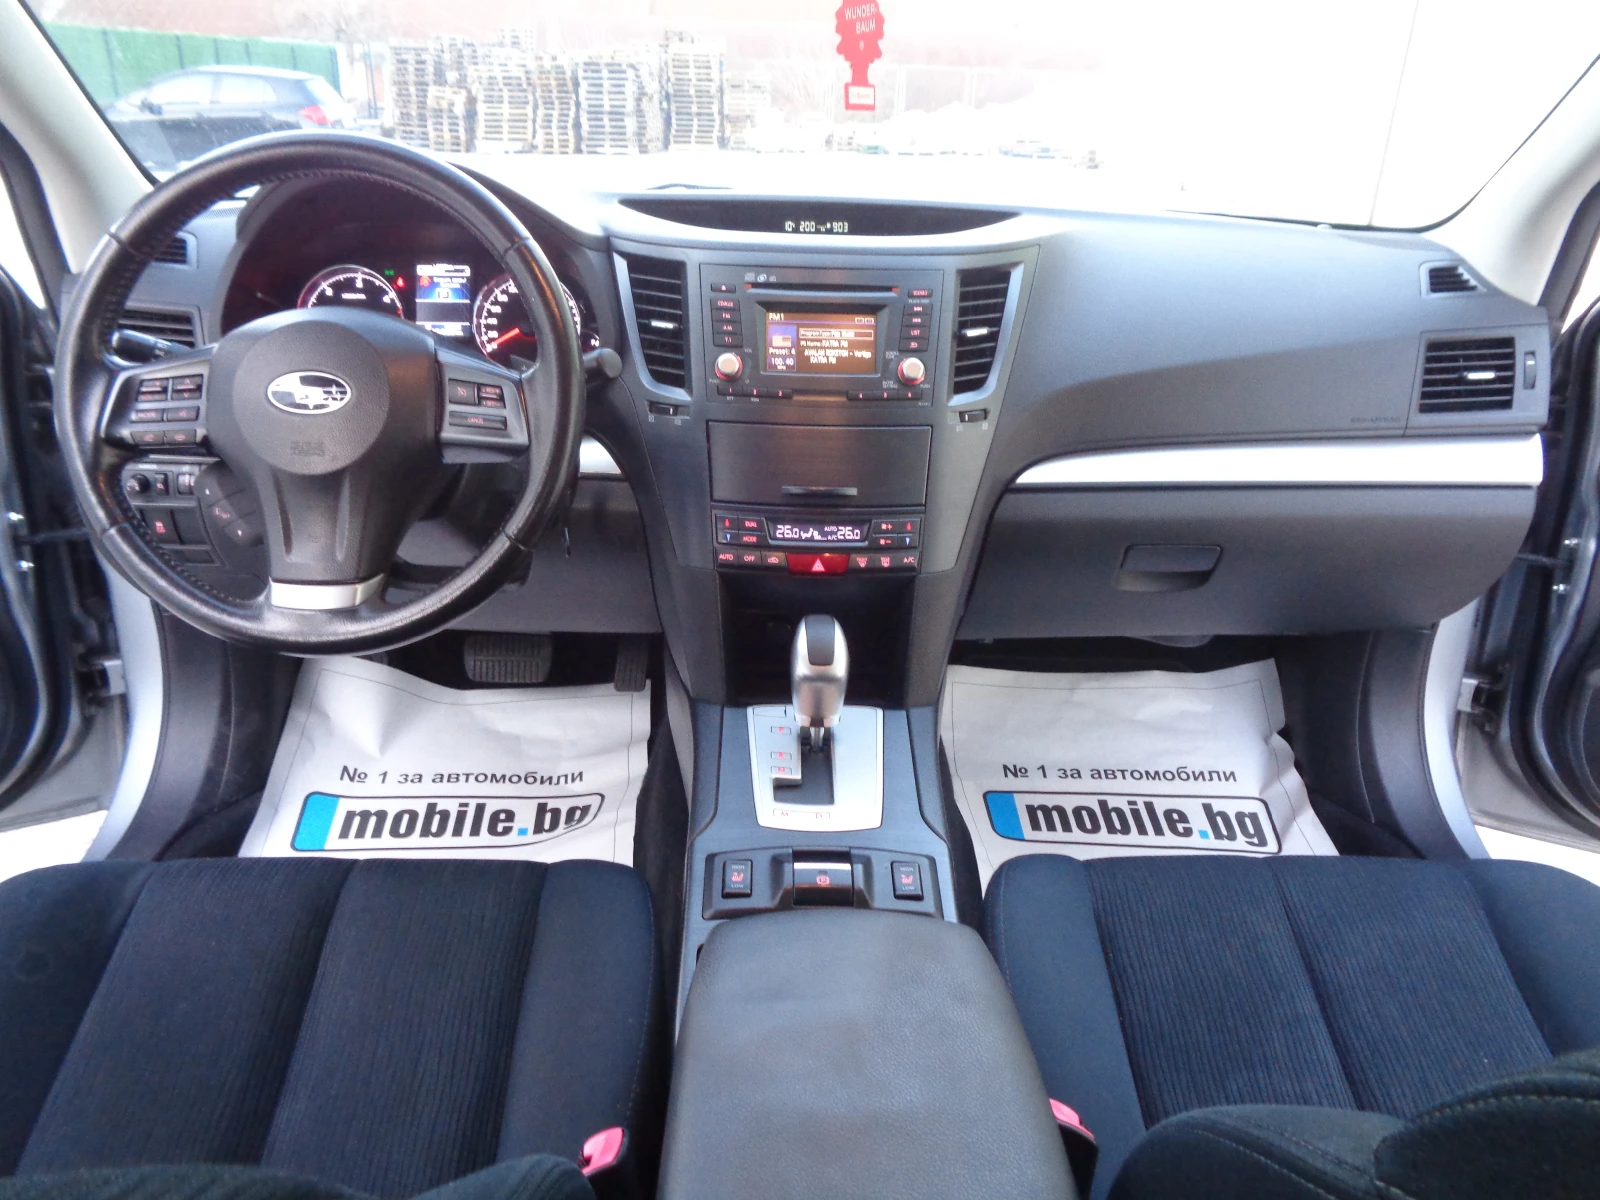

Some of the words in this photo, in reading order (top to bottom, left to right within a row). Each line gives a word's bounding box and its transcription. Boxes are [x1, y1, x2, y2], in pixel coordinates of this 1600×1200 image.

[844, 3, 878, 20] WUNDER-
[855, 19, 876, 34] BAUM
[775, 524, 800, 539] 26.0
[837, 526, 861, 540] 26.0
[719, 553, 734, 561] AUTO
[743, 555, 756, 563] OFF
[903, 556, 915, 564] A/C
[777, 726, 785, 734] P
[378, 771, 388, 784] 1
[397, 773, 424, 784] за
[431, 771, 584, 787] автомобили
[1036, 765, 1048, 779] 1
[1057, 768, 1082, 780] за
[1090, 766, 1237, 783] автомобили
[338, 802, 592, 840] mobile.bg
[1025, 799, 1268, 848] mobile.bg
